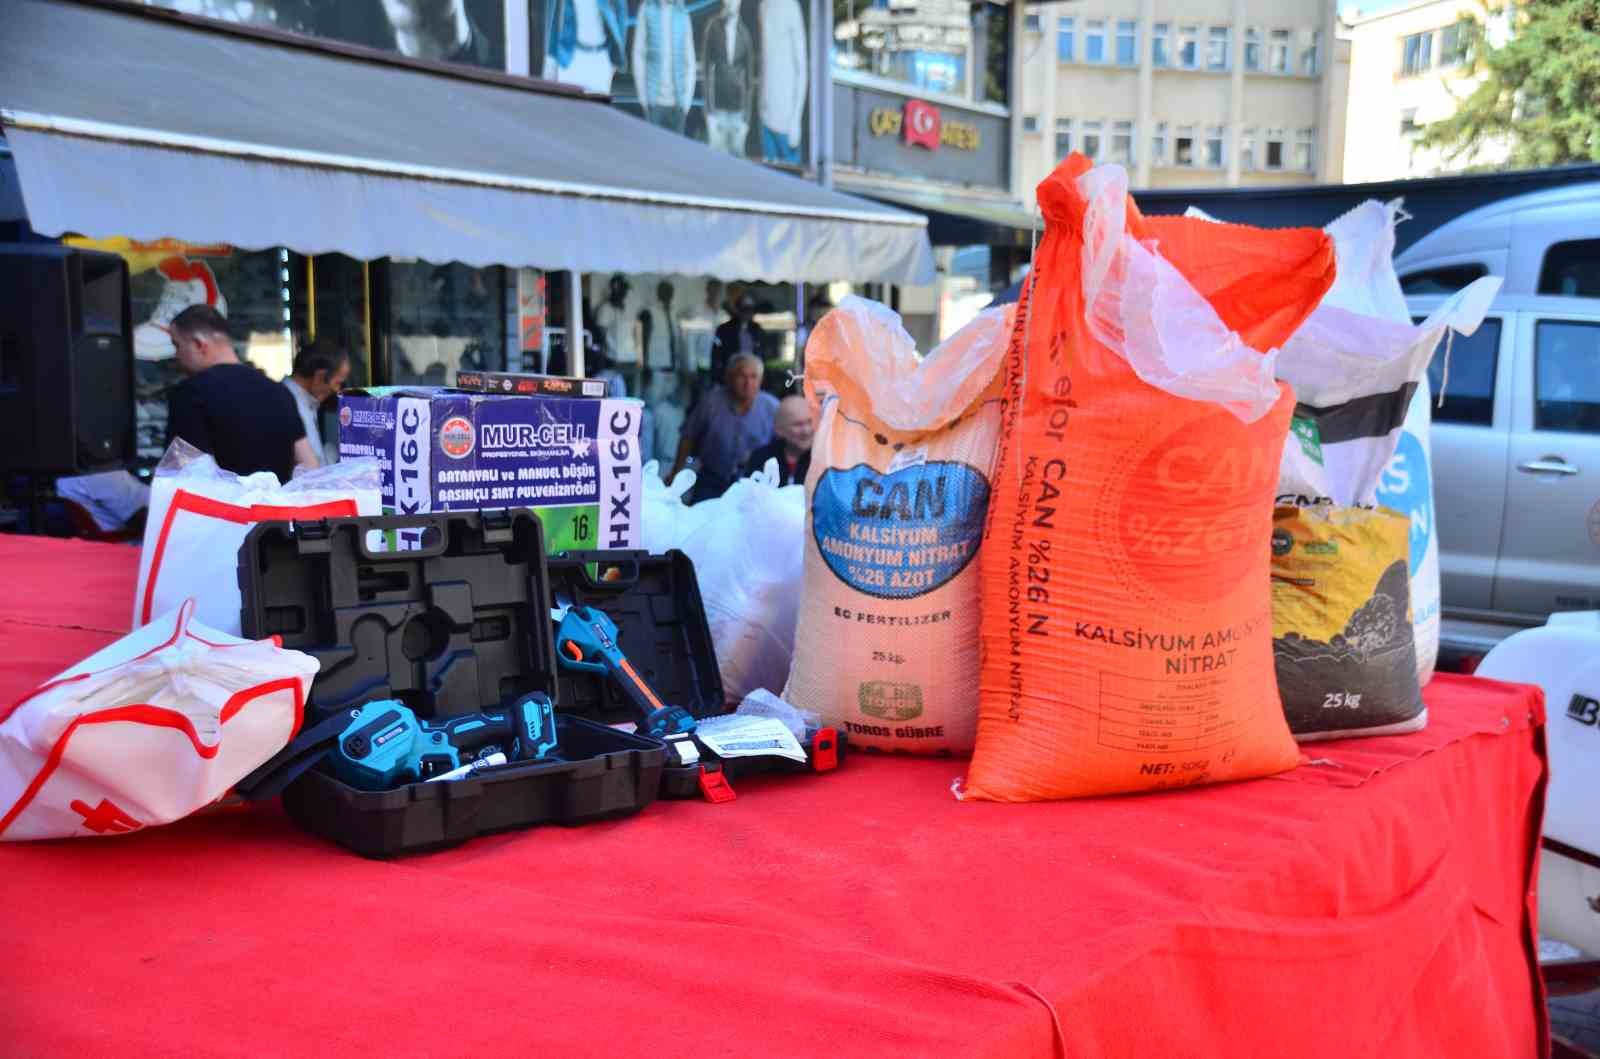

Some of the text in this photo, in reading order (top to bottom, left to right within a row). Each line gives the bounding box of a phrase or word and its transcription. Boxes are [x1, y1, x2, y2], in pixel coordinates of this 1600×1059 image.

[1044, 375, 1078, 442] efor
[481, 423, 587, 449] MUR-CELL
[438, 469, 499, 483] BATARYALI
[518, 467, 561, 481] MANUEL
[563, 463, 596, 480] DÜŞÜK
[609, 411, 632, 549] HX-16C
[438, 481, 597, 503] BASINÇLI SIRT PULVERİZATÖRÜ
[851, 475, 947, 521] CAN
[572, 514, 588, 541] 16
[849, 522, 940, 546] KALSİYUM
[821, 536, 904, 566] AMONYUM
[1027, 459, 1067, 637] CAN %26 N
[848, 565, 935, 589] %26 AZOT
[1008, 456, 1039, 723] KALSİYUM AMONYUM NİTRAT
[856, 609, 951, 627] FERTILIZER
[1074, 621, 1195, 652] KALSİYUM
[1165, 648, 1237, 676] NİTRAT
[1322, 691, 1362, 710] 25 kg
[843, 721, 945, 739] TOROS GÜBRE
[1139, 762, 1176, 776] NET:
